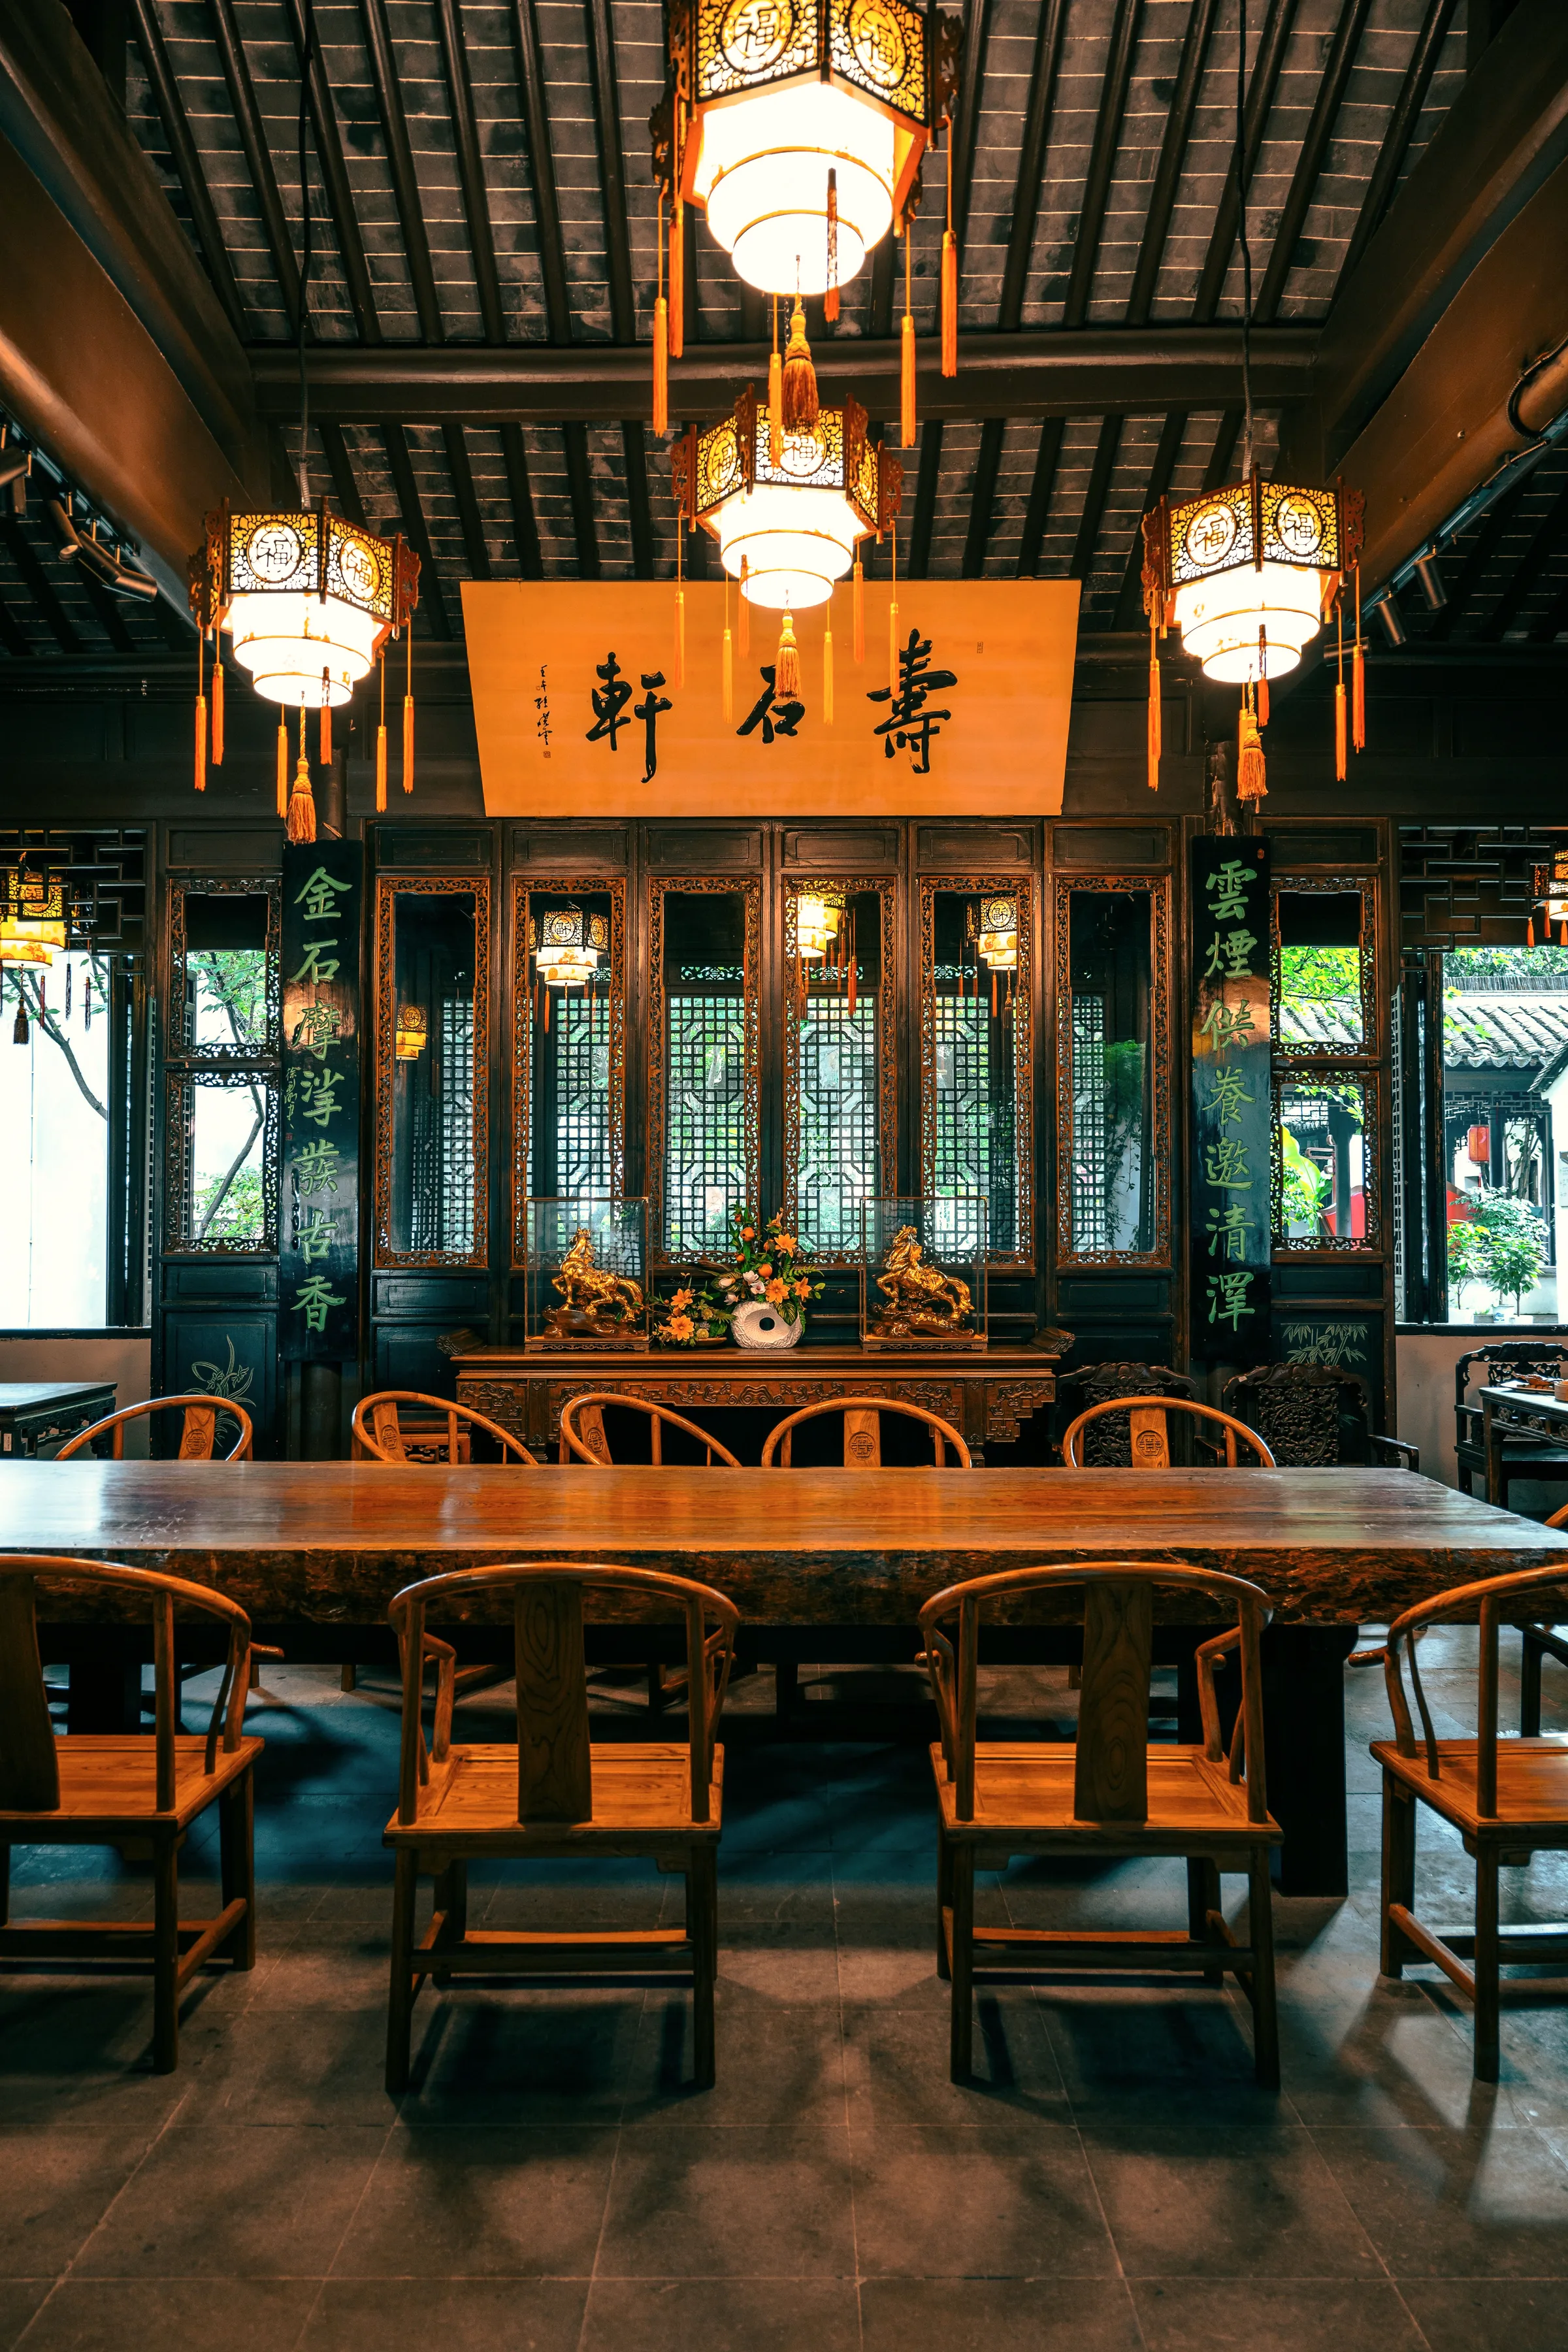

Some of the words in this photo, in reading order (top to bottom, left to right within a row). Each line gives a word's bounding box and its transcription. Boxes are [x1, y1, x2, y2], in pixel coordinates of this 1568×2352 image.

[734, 3, 776, 52] 福
[860, 10, 896, 70] 福
[784, 438, 813, 461] 福
[1196, 518, 1226, 552] 福
[1285, 514, 1314, 541] 福
[257, 539, 287, 567] 福
[350, 555, 372, 585] 福
